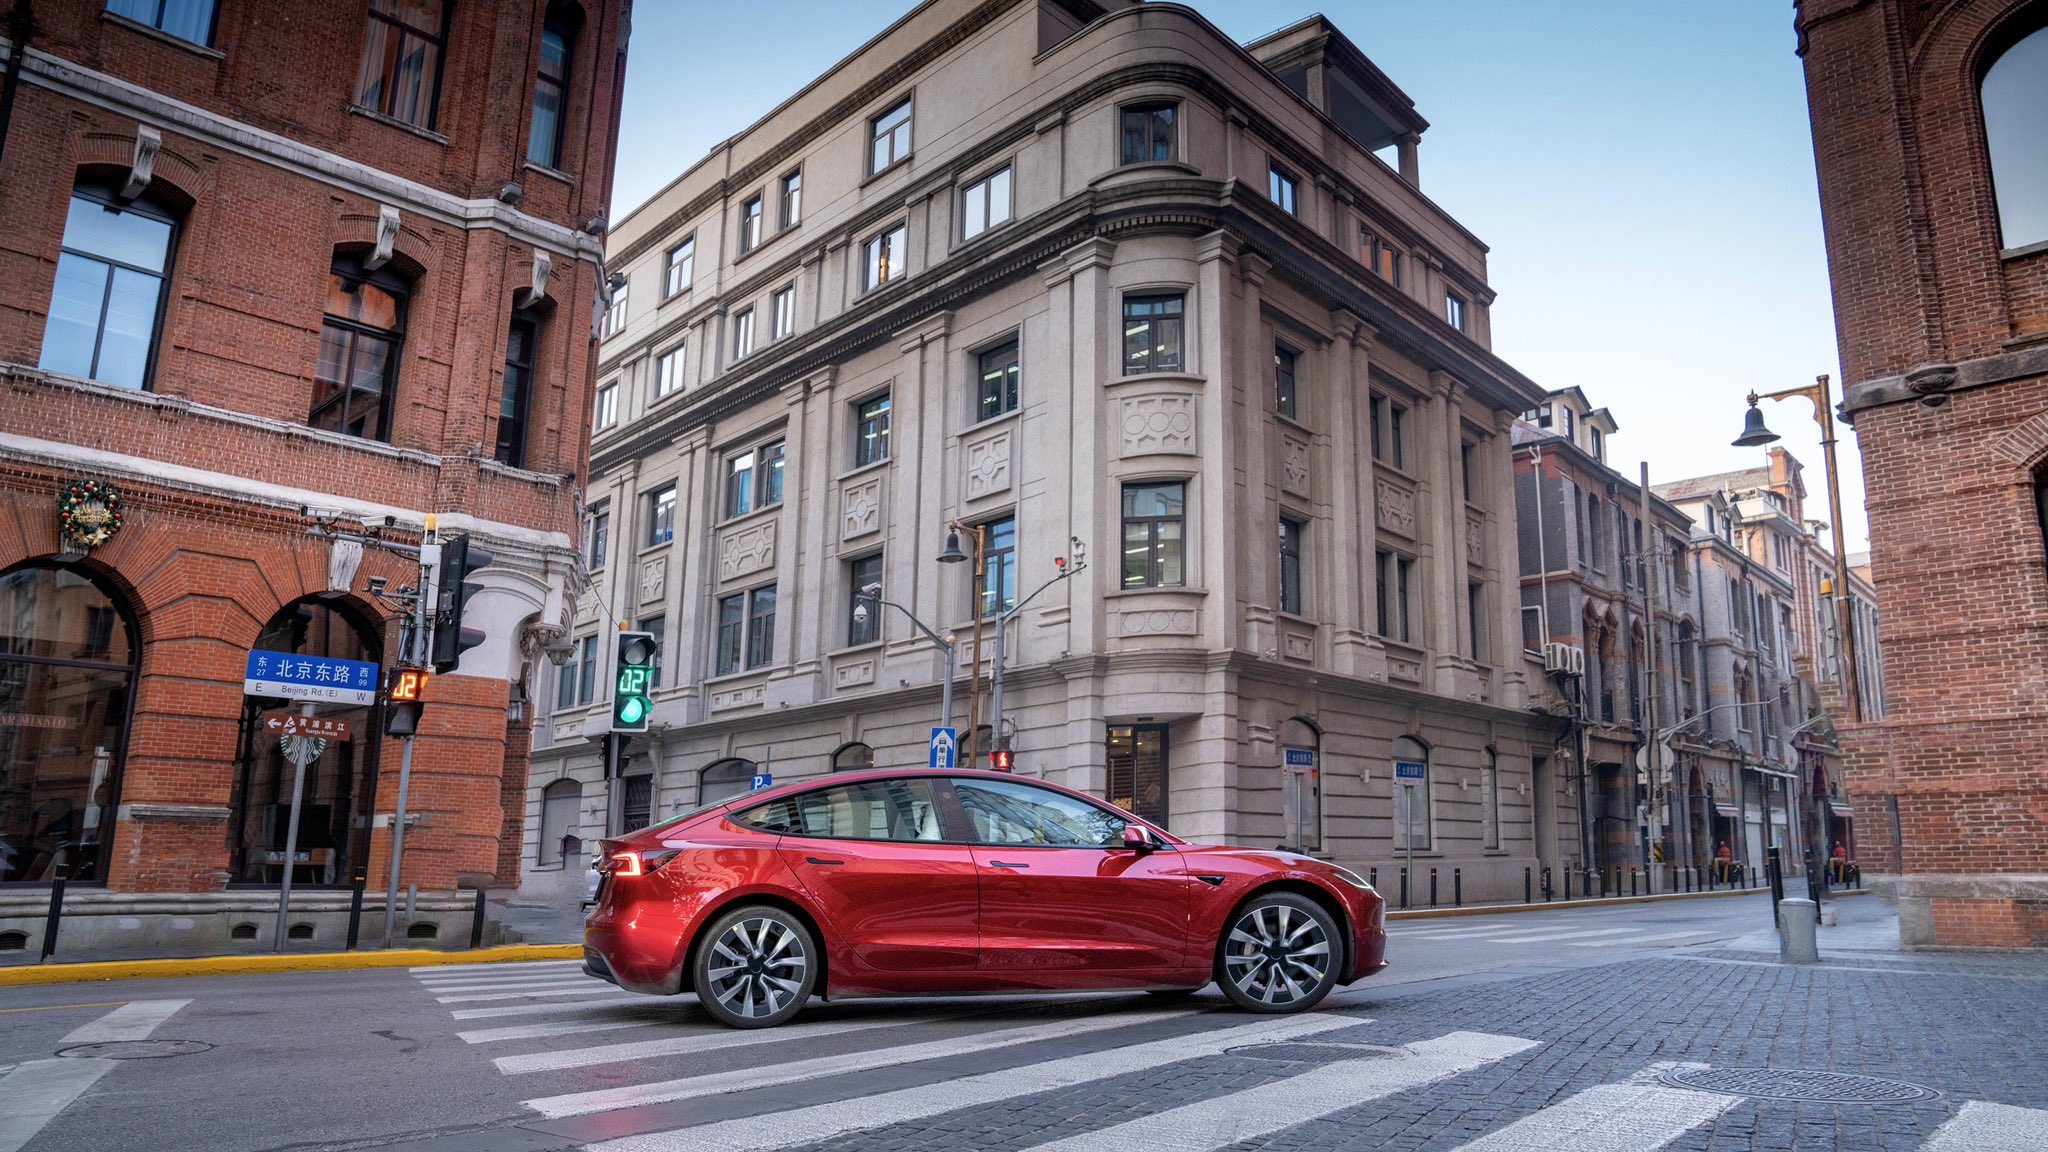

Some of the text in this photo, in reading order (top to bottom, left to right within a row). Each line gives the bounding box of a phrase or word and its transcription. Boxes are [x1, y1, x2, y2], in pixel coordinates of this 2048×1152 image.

[258, 656, 268, 667] 东
[256, 668, 267, 676] 27
[276, 659, 350, 684] 北京东路
[359, 667, 369, 678] 西
[358, 679, 368, 687] 99
[619, 669, 644, 693] 02
[255, 682, 262, 692] E
[281, 685, 308, 696] Beijing
[356, 692, 366, 701] W
[754, 775, 763, 790] P
